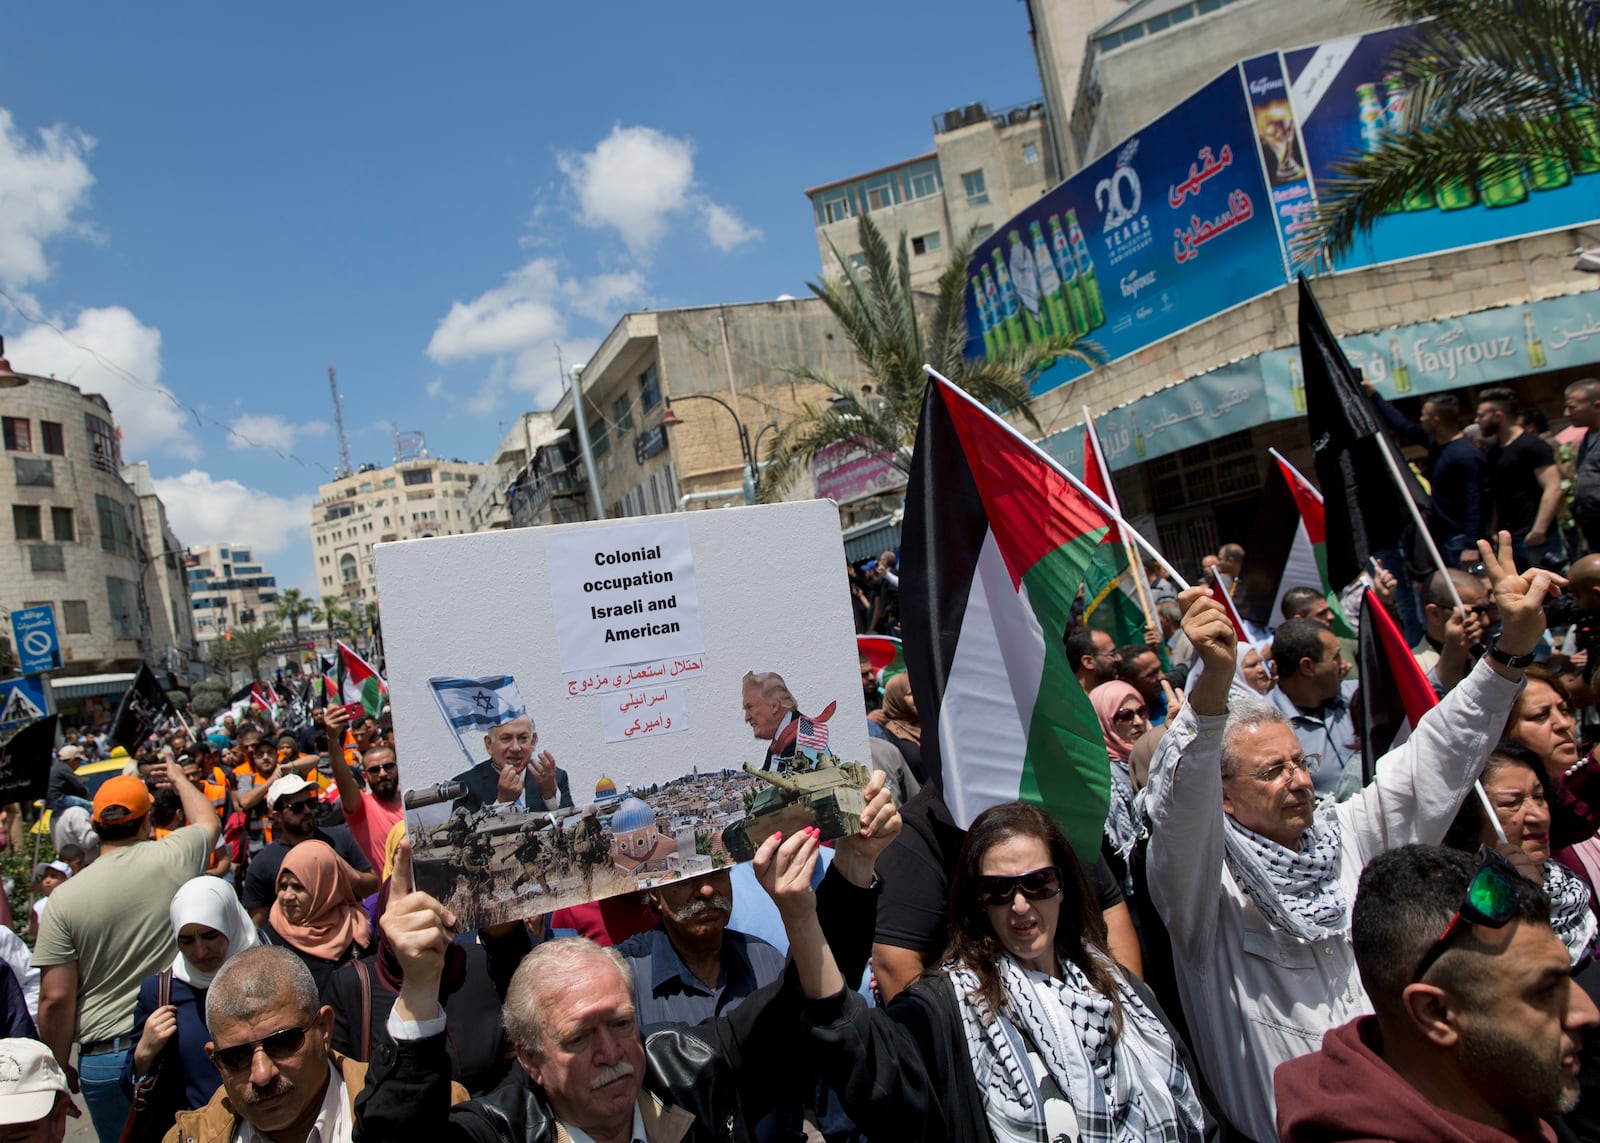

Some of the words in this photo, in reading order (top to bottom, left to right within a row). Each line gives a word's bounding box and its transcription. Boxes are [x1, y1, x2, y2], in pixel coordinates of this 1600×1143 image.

[1169, 144, 1233, 209] مقهى
[1095, 166, 1142, 234] 20
[1105, 215, 1150, 250] YEARS
[1174, 189, 1254, 264] فلسطين
[1413, 335, 1517, 380] fayrouz
[594, 546, 661, 566] Colonial
[583, 570, 673, 592] occupation
[591, 599, 643, 620] Israeli
[647, 595, 677, 612] and
[604, 622, 680, 643] American
[612, 664, 666, 688] استعماري
[669, 658, 703, 677] احتلال
[567, 676, 608, 696] مزدوج
